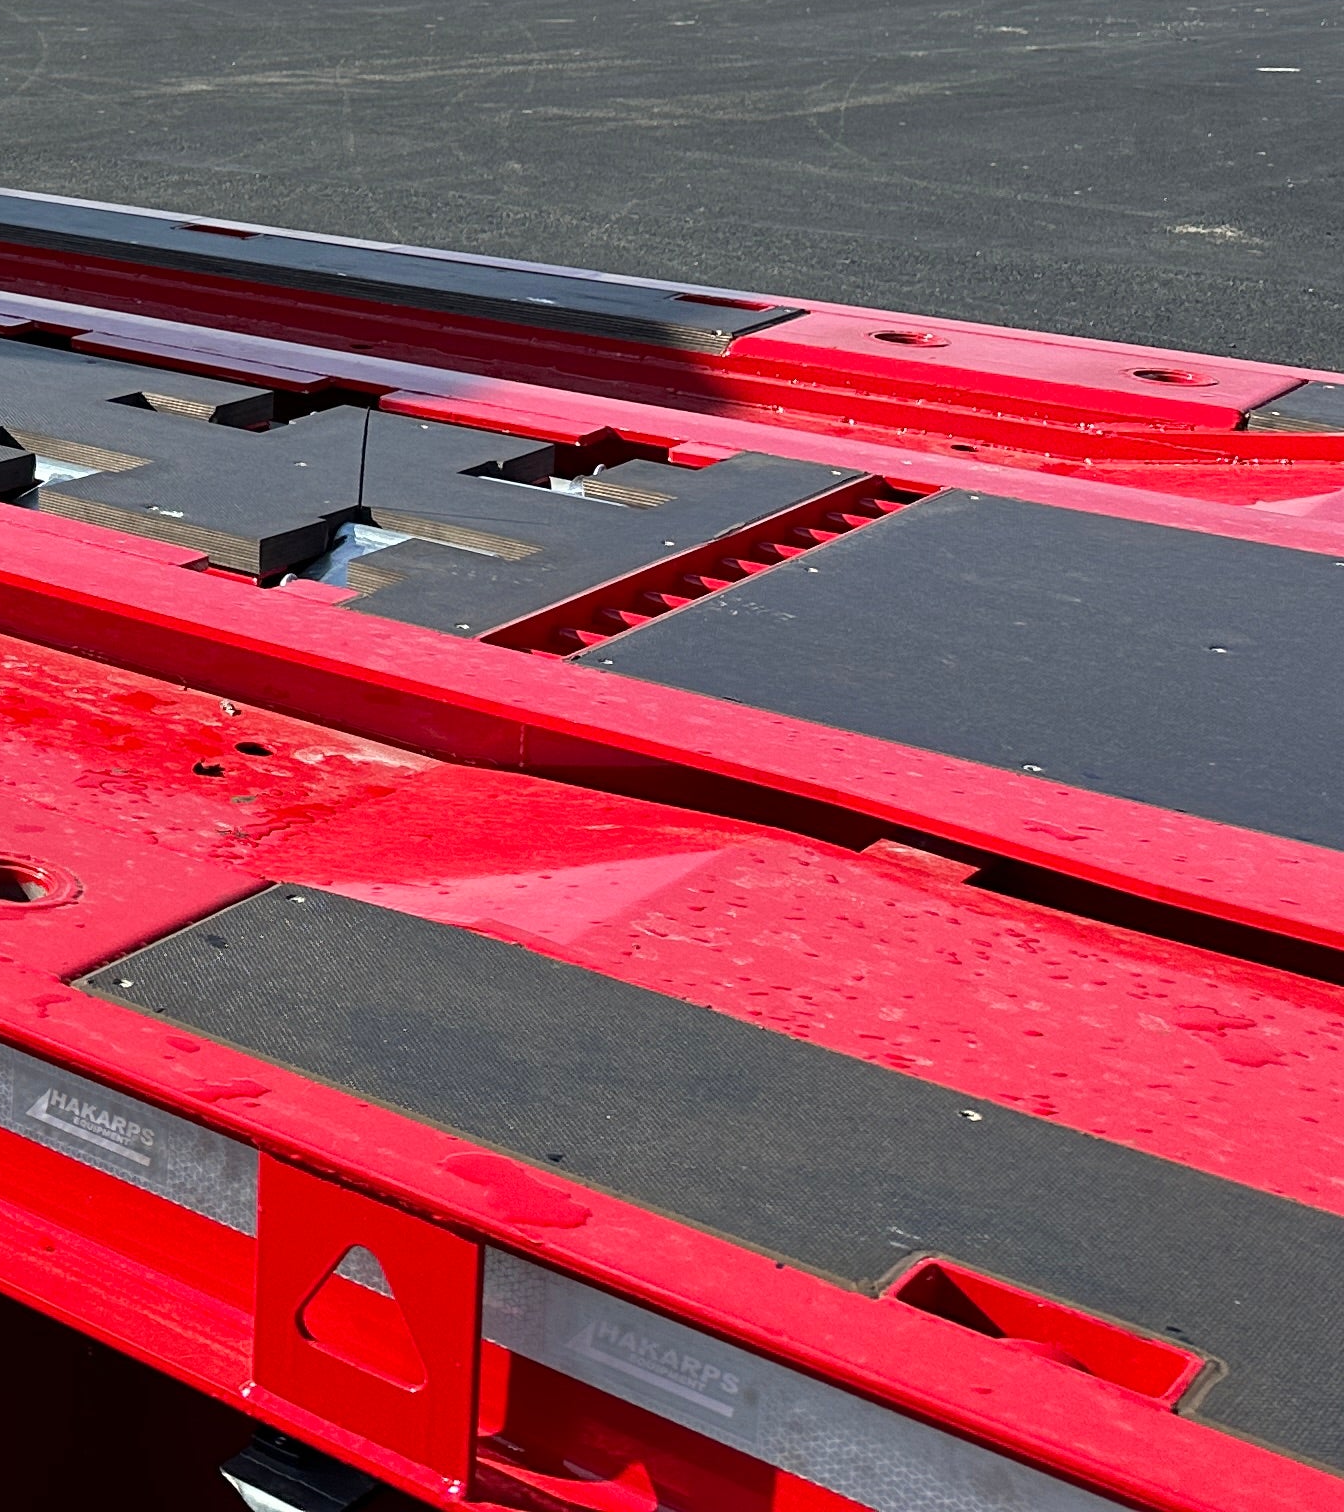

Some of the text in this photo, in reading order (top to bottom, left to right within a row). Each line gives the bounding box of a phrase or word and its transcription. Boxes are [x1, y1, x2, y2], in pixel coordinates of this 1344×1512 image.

[50, 1089, 155, 1147] HAKARPS
[72, 1115, 132, 1147] EQUIPMENT
[598, 1319, 740, 1395] HAKARPS
